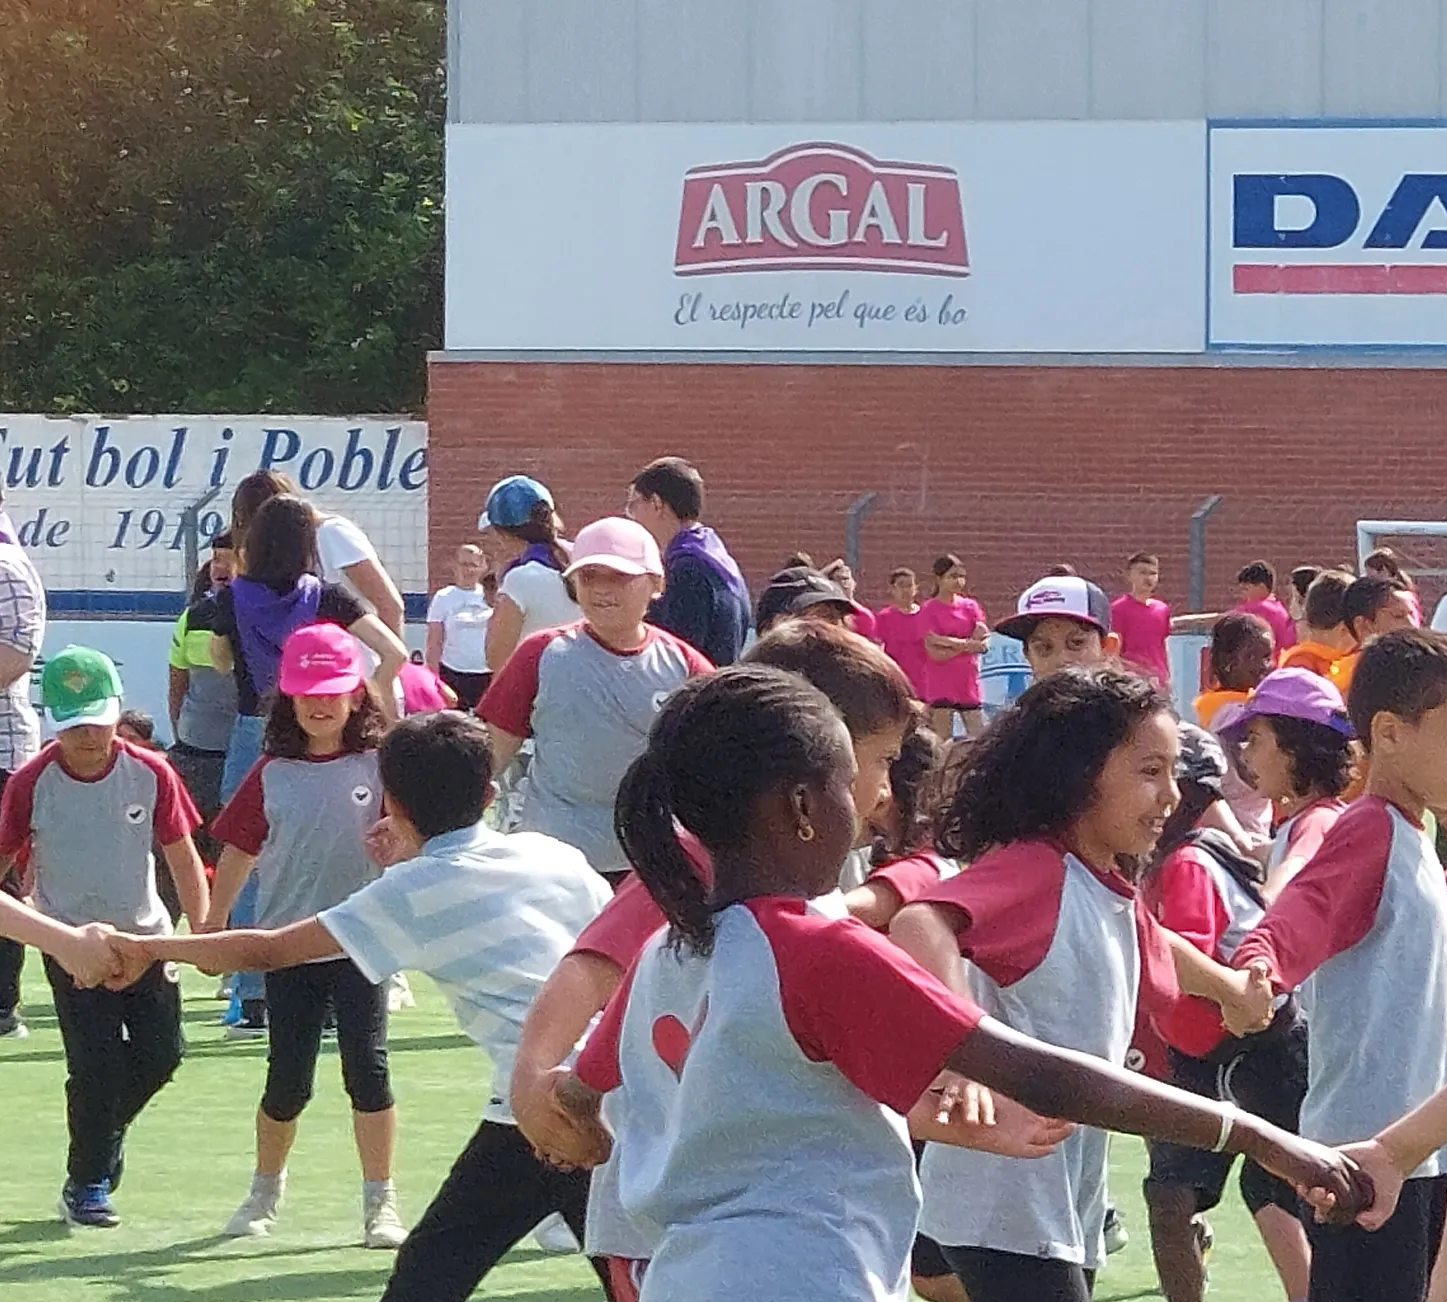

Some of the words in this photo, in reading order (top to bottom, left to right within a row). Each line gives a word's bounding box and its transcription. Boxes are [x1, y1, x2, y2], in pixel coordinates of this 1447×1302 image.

[691, 173, 949, 249] ARGAL
[674, 292, 702, 326] El
[709, 293, 802, 329] respecte
[807, 289, 850, 328] pel
[853, 299, 897, 328] que
[938, 294, 968, 326] bo
[210, 428, 233, 488] i
[259, 427, 426, 491] Poble
[18, 508, 70, 547] de
